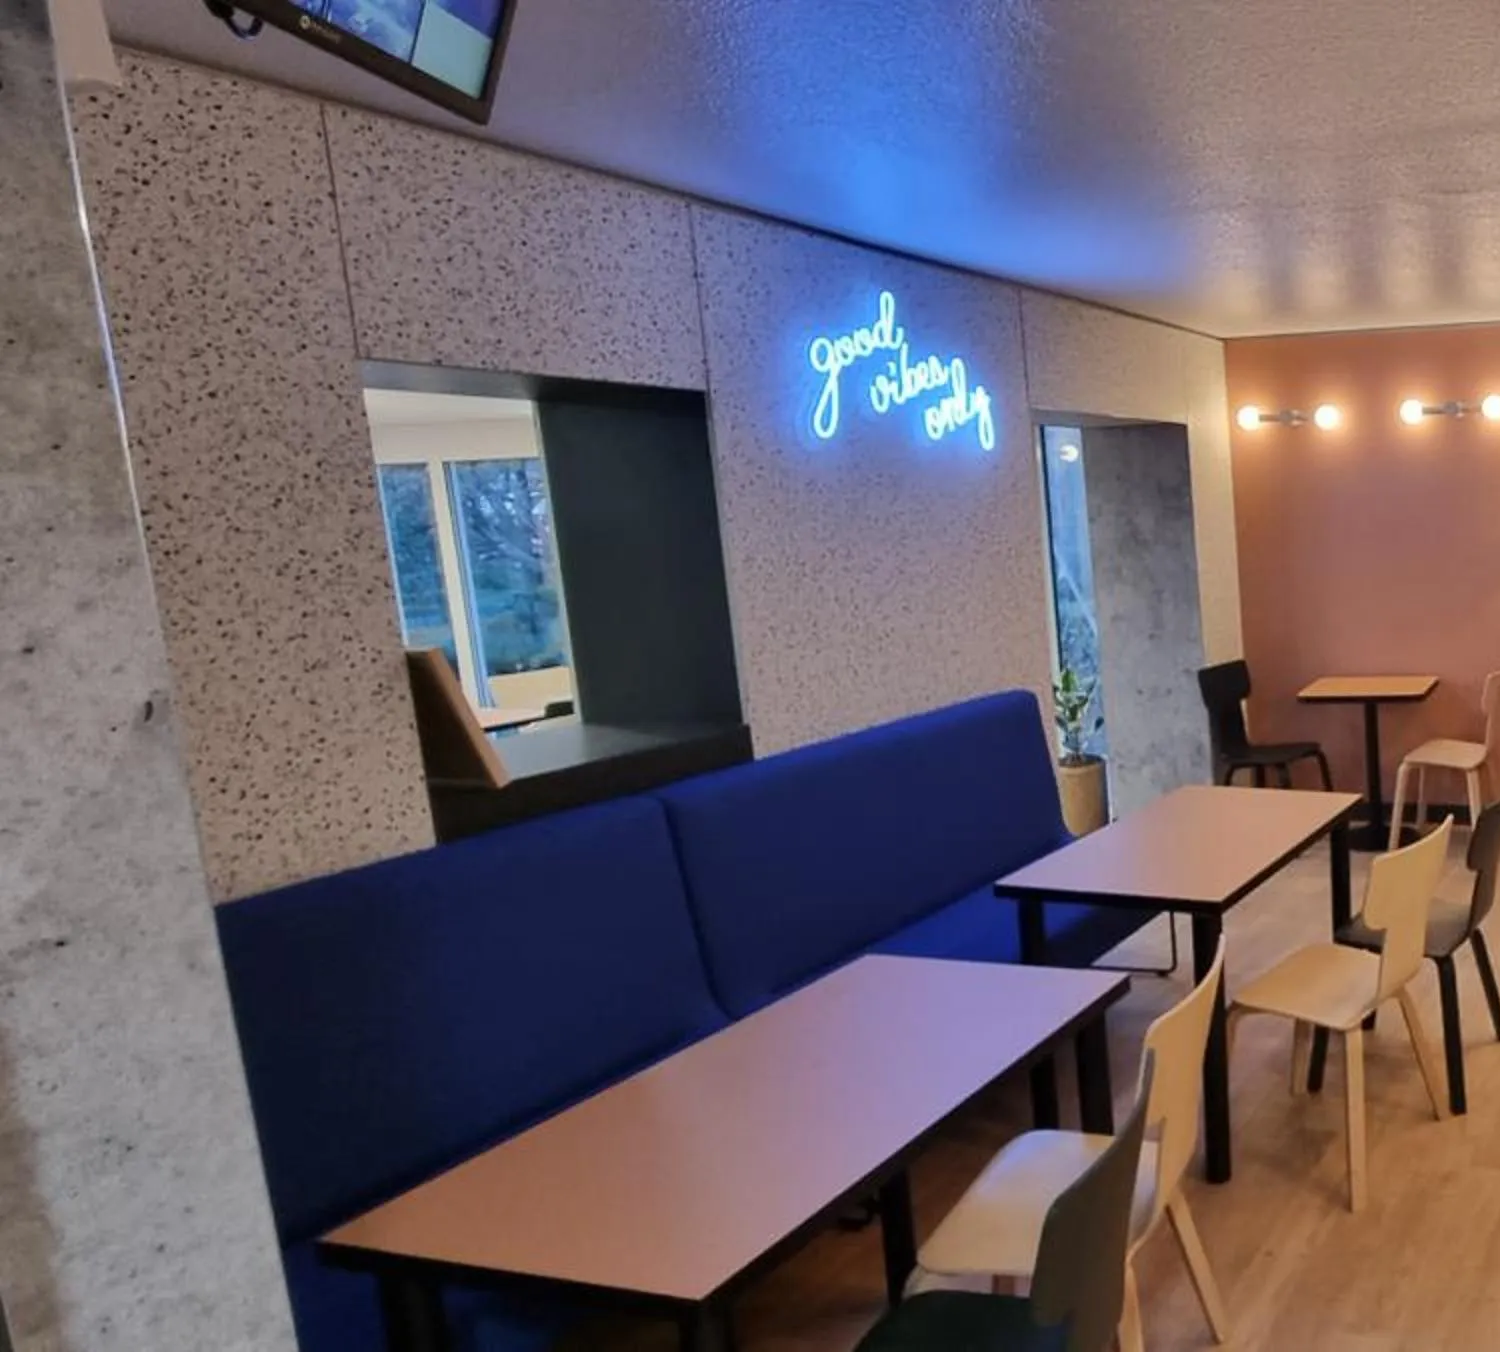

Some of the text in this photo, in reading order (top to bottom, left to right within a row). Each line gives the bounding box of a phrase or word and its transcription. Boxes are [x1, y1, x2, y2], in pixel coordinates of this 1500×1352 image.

[810, 291, 904, 439] good
[869, 341, 950, 414] vibes
[923, 357, 995, 451] only
